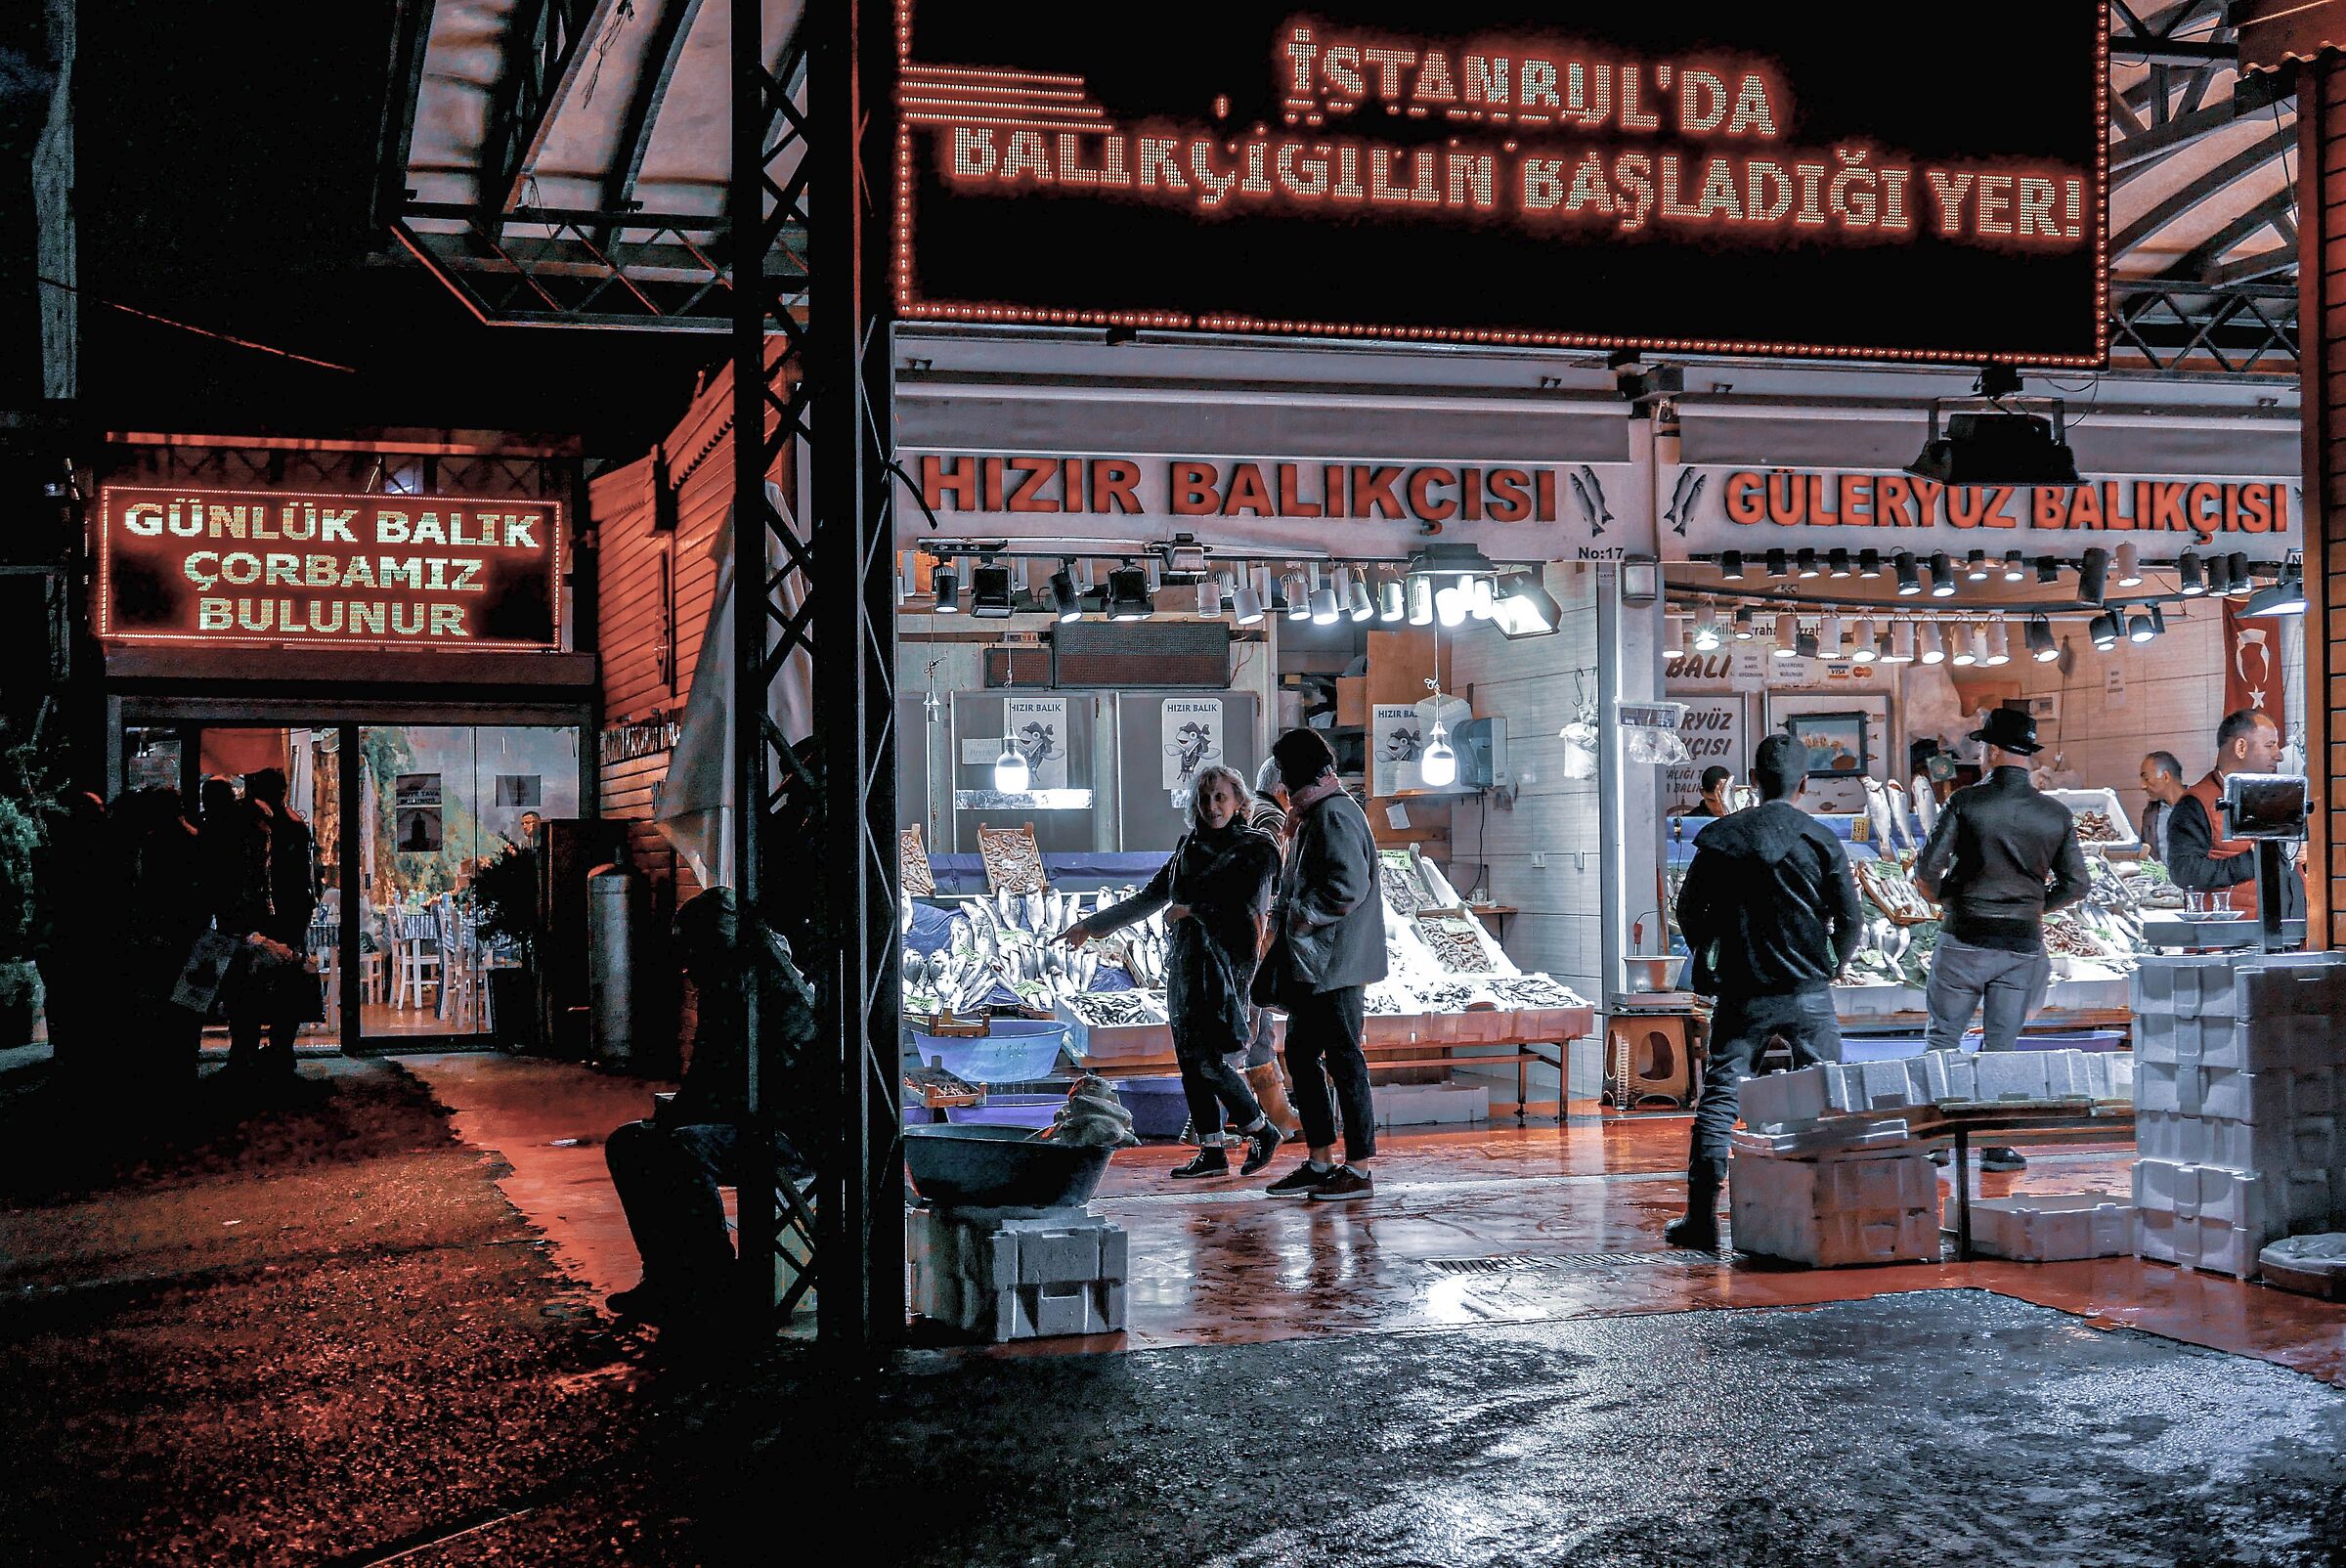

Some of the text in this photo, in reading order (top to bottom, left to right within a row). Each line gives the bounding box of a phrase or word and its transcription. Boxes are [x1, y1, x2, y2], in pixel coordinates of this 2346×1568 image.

[1524, 149, 1909, 229] BAŞLADIĞI
[1927, 170, 2082, 238] YER!
[921, 456, 1556, 537] HIZIR BALIKÇISI
[2031, 480, 2287, 545] BALIKÇISI
[124, 498, 542, 549] GÜNLÜK BALIK
[183, 549, 486, 592] ÇORBAMIZ
[1578, 546, 1624, 560] No:17
[198, 597, 471, 637] BULUNUR
[1666, 653, 1732, 678] BALI
[1378, 710, 1402, 719] HIZIR
[1680, 707, 1734, 731] RYÜZ
